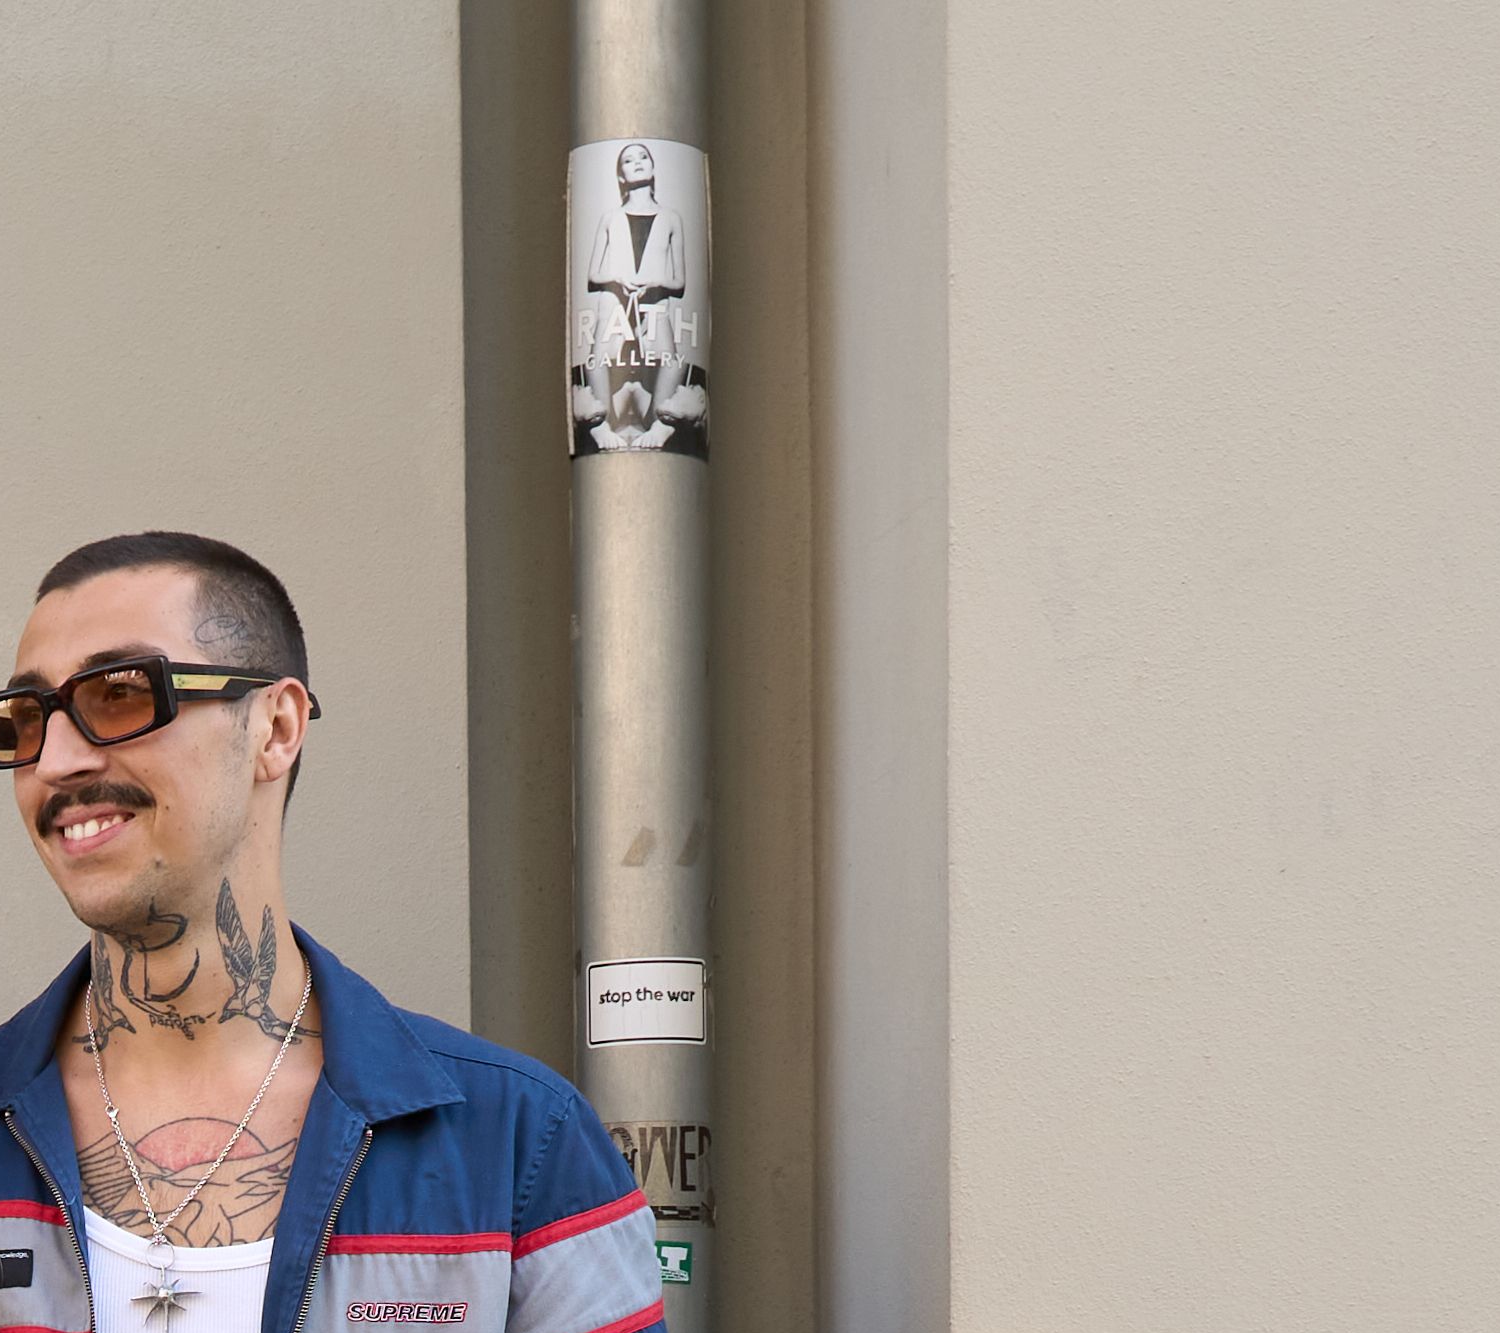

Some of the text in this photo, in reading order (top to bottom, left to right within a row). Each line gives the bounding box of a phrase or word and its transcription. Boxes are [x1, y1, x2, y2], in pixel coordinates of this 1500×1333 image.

[577, 303, 698, 348] RATH
[585, 349, 686, 370] GALLERY
[599, 986, 695, 1007] stop the war
[347, 1302, 469, 1323] SUPREME
